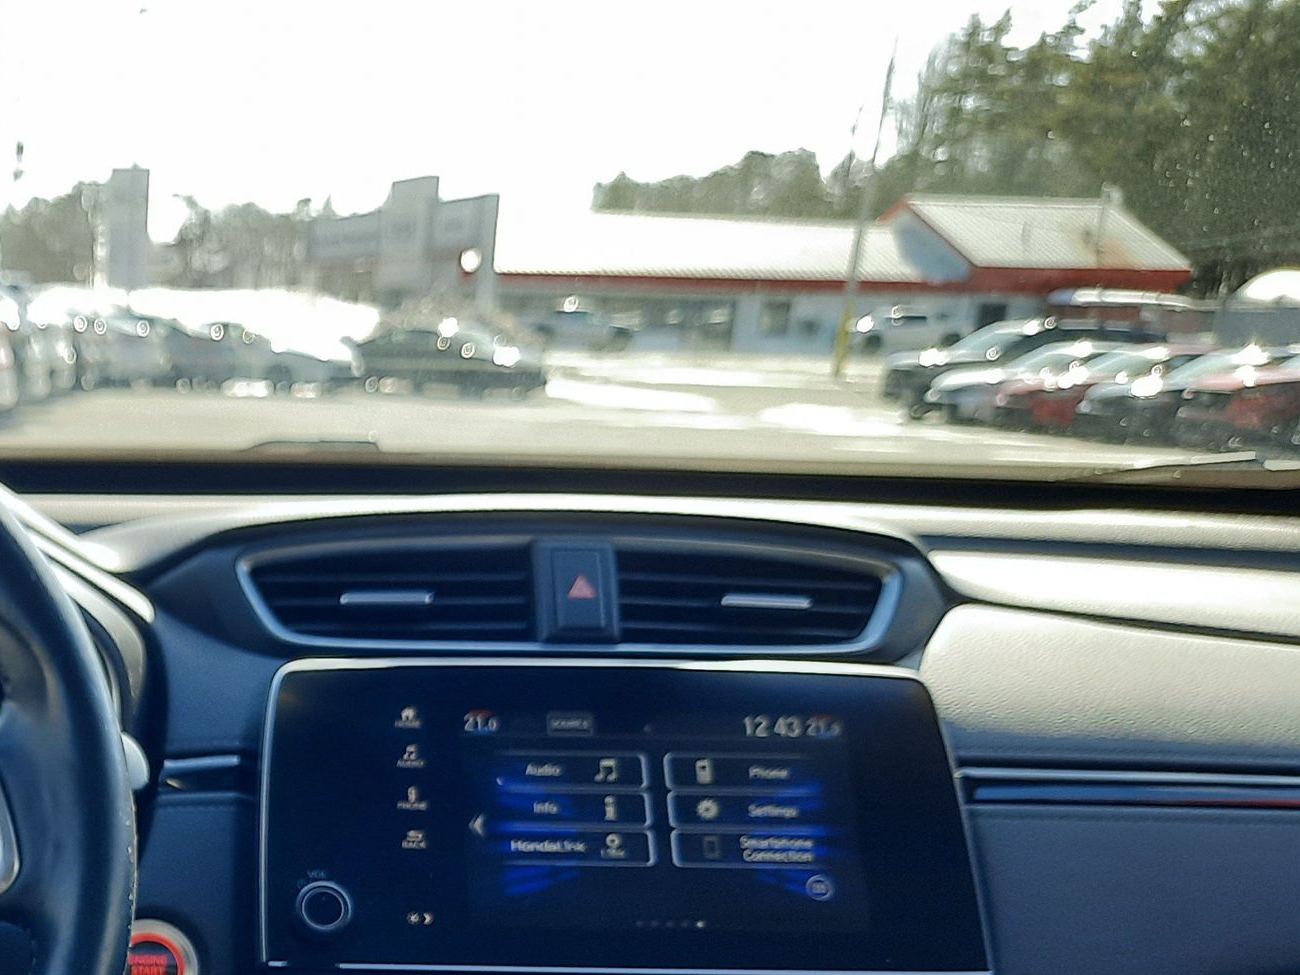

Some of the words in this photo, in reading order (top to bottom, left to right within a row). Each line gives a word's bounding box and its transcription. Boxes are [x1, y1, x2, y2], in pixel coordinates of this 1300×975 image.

[526, 763, 562, 777] Audio
[750, 766, 790, 779] Phone
[534, 801, 557, 814] Info
[749, 805, 798, 819] Settings
[743, 849, 814, 862] Connection
